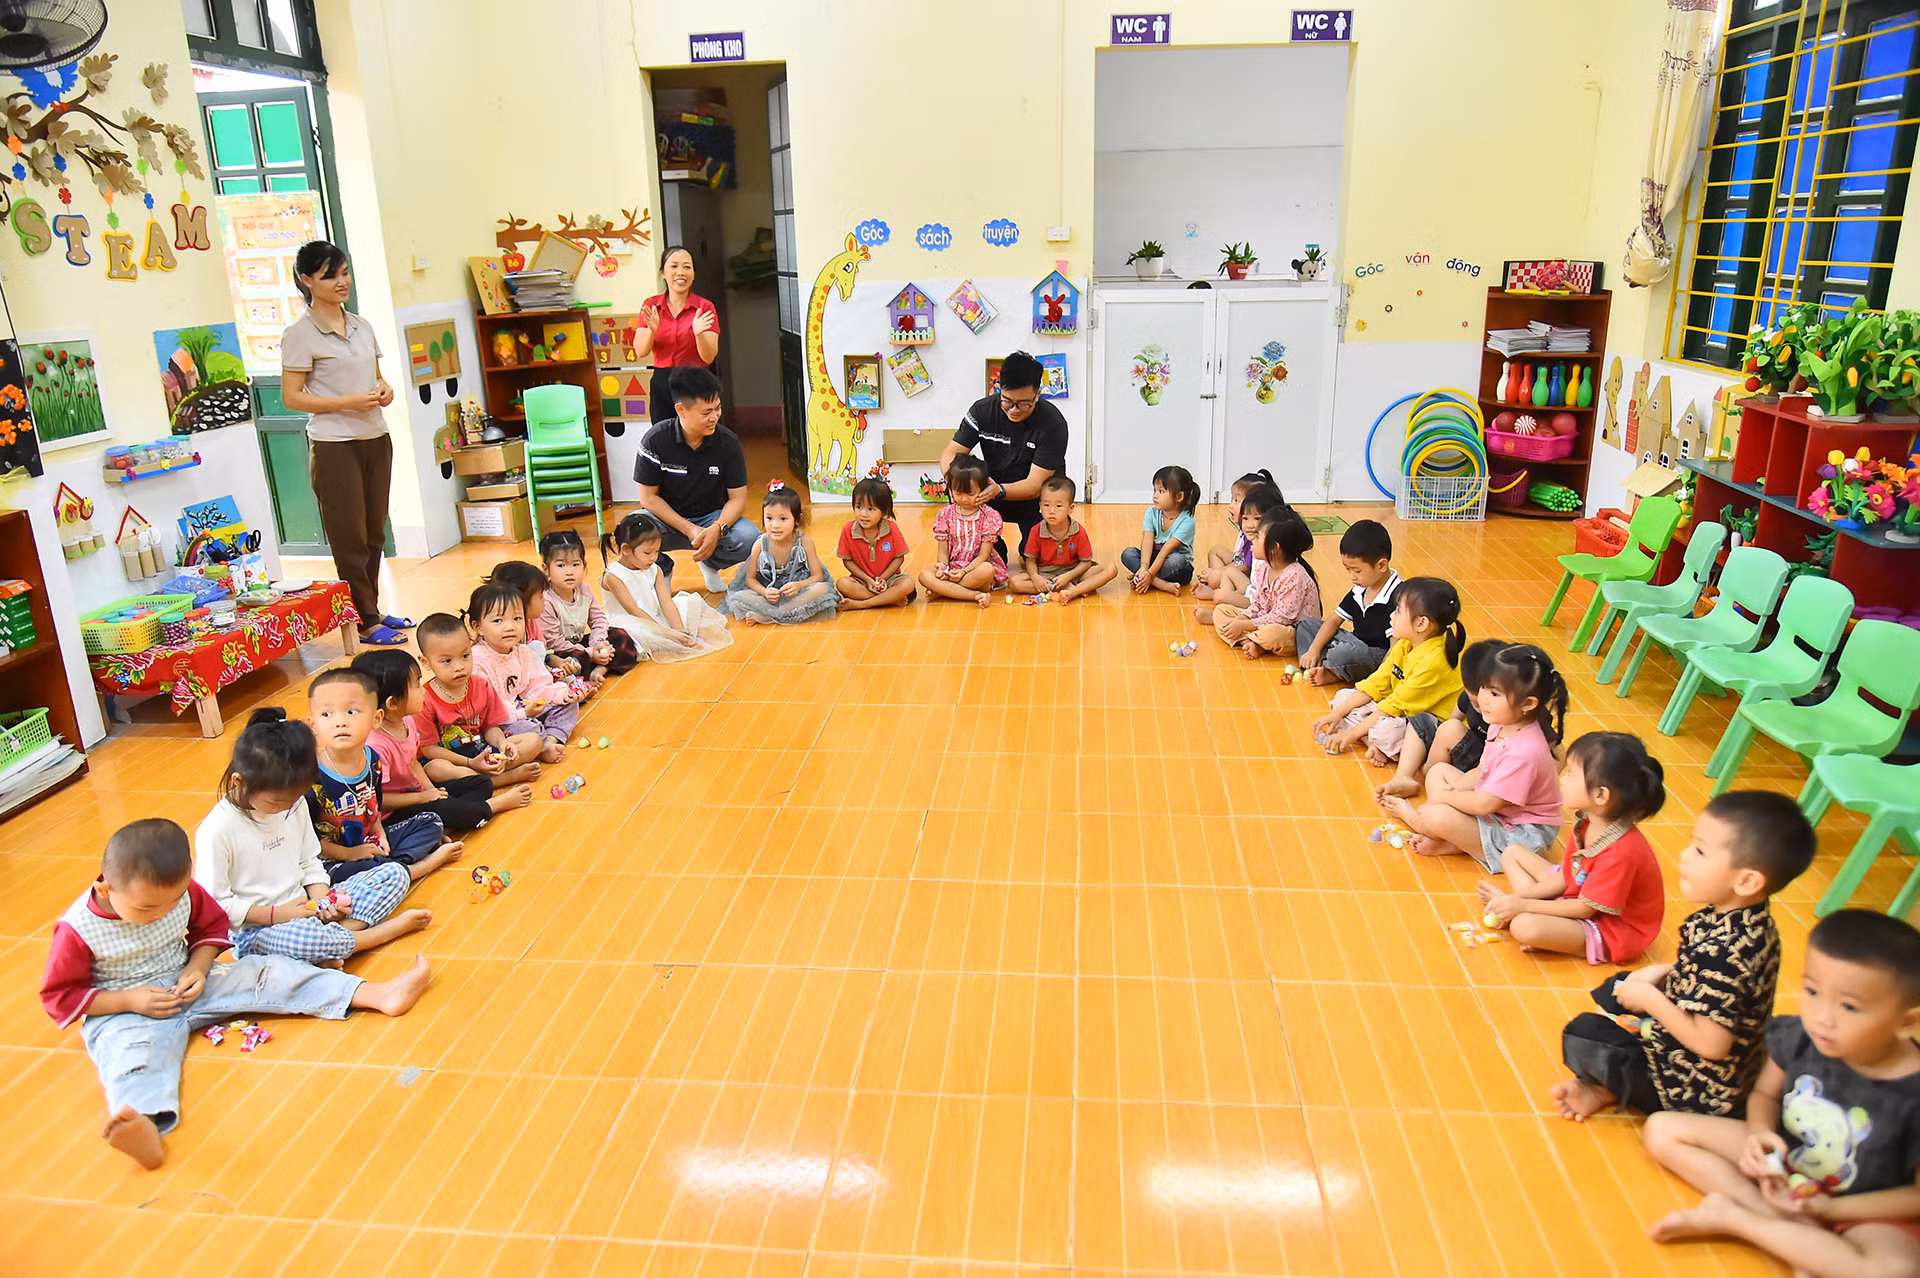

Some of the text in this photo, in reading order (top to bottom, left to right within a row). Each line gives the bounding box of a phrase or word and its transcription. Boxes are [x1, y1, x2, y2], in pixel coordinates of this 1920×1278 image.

[1116, 18, 1148, 34] WC
[1296, 14, 1329, 30] WC
[1305, 31, 1318, 39] NỮ
[692, 37, 742, 59] PHÒNG KHO
[860, 224, 1018, 246] Góc sách truyện
[1355, 252, 1481, 278] Góc vận động
[600, 349, 636, 363] 3 4
